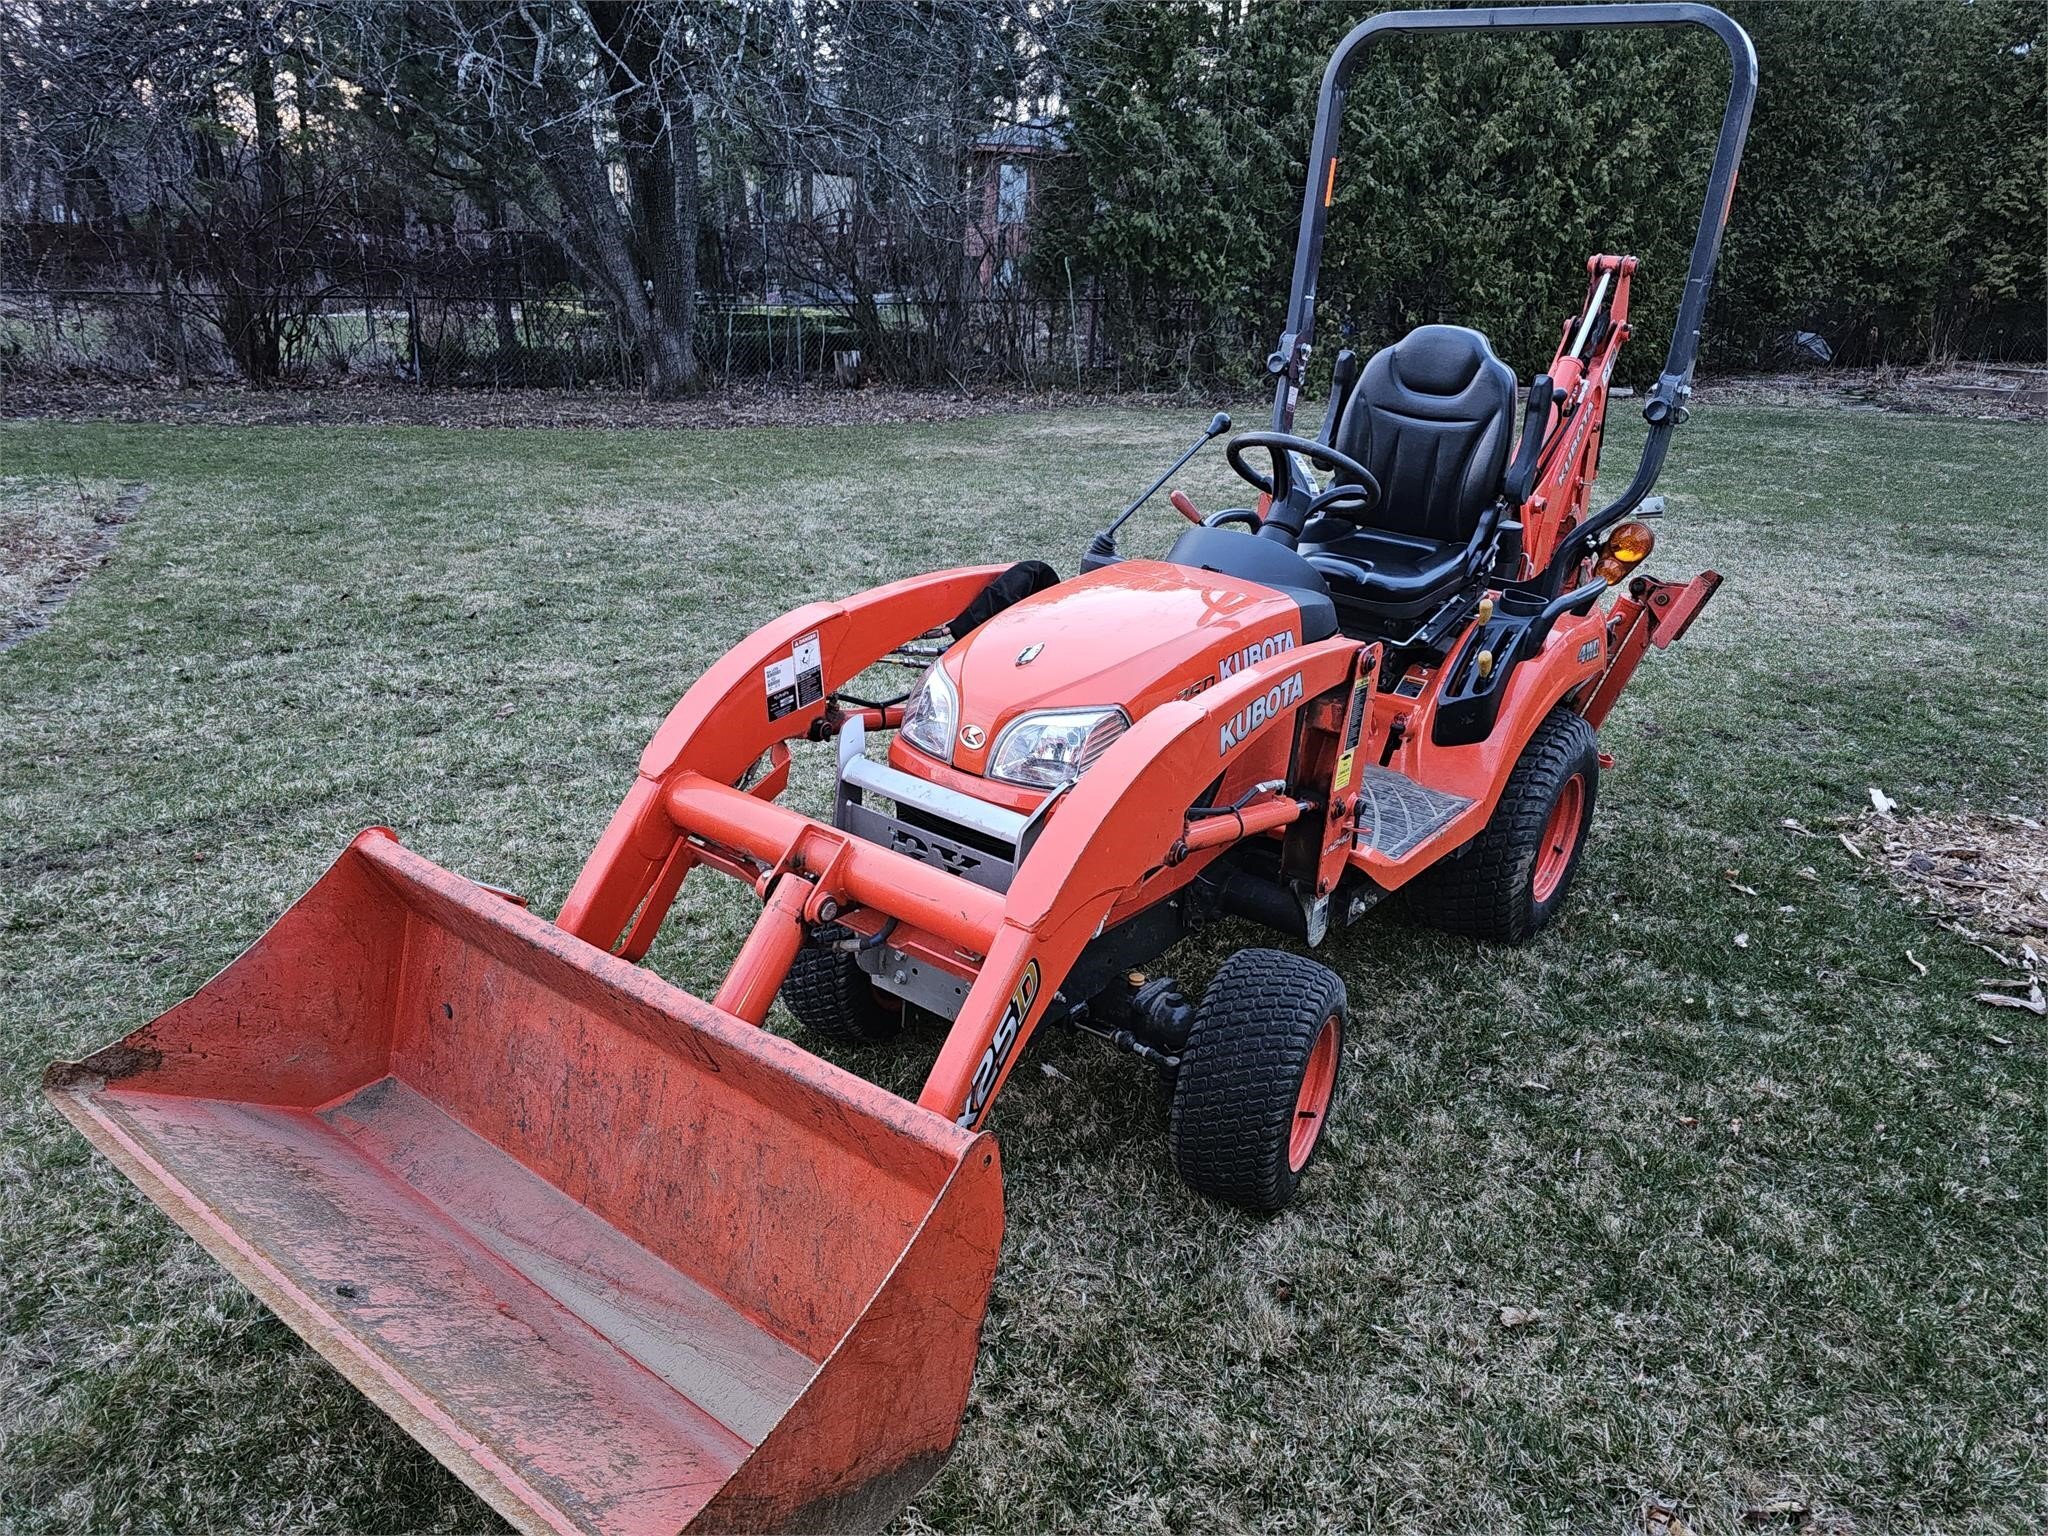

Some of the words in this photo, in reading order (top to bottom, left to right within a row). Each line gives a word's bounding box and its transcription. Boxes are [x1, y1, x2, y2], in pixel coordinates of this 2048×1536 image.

[1557, 401, 1594, 488] KUBOTA
[1218, 629, 1296, 681] KUBOTA
[1577, 637, 1600, 664] 4WD
[1220, 671, 1304, 757] KUBOTA
